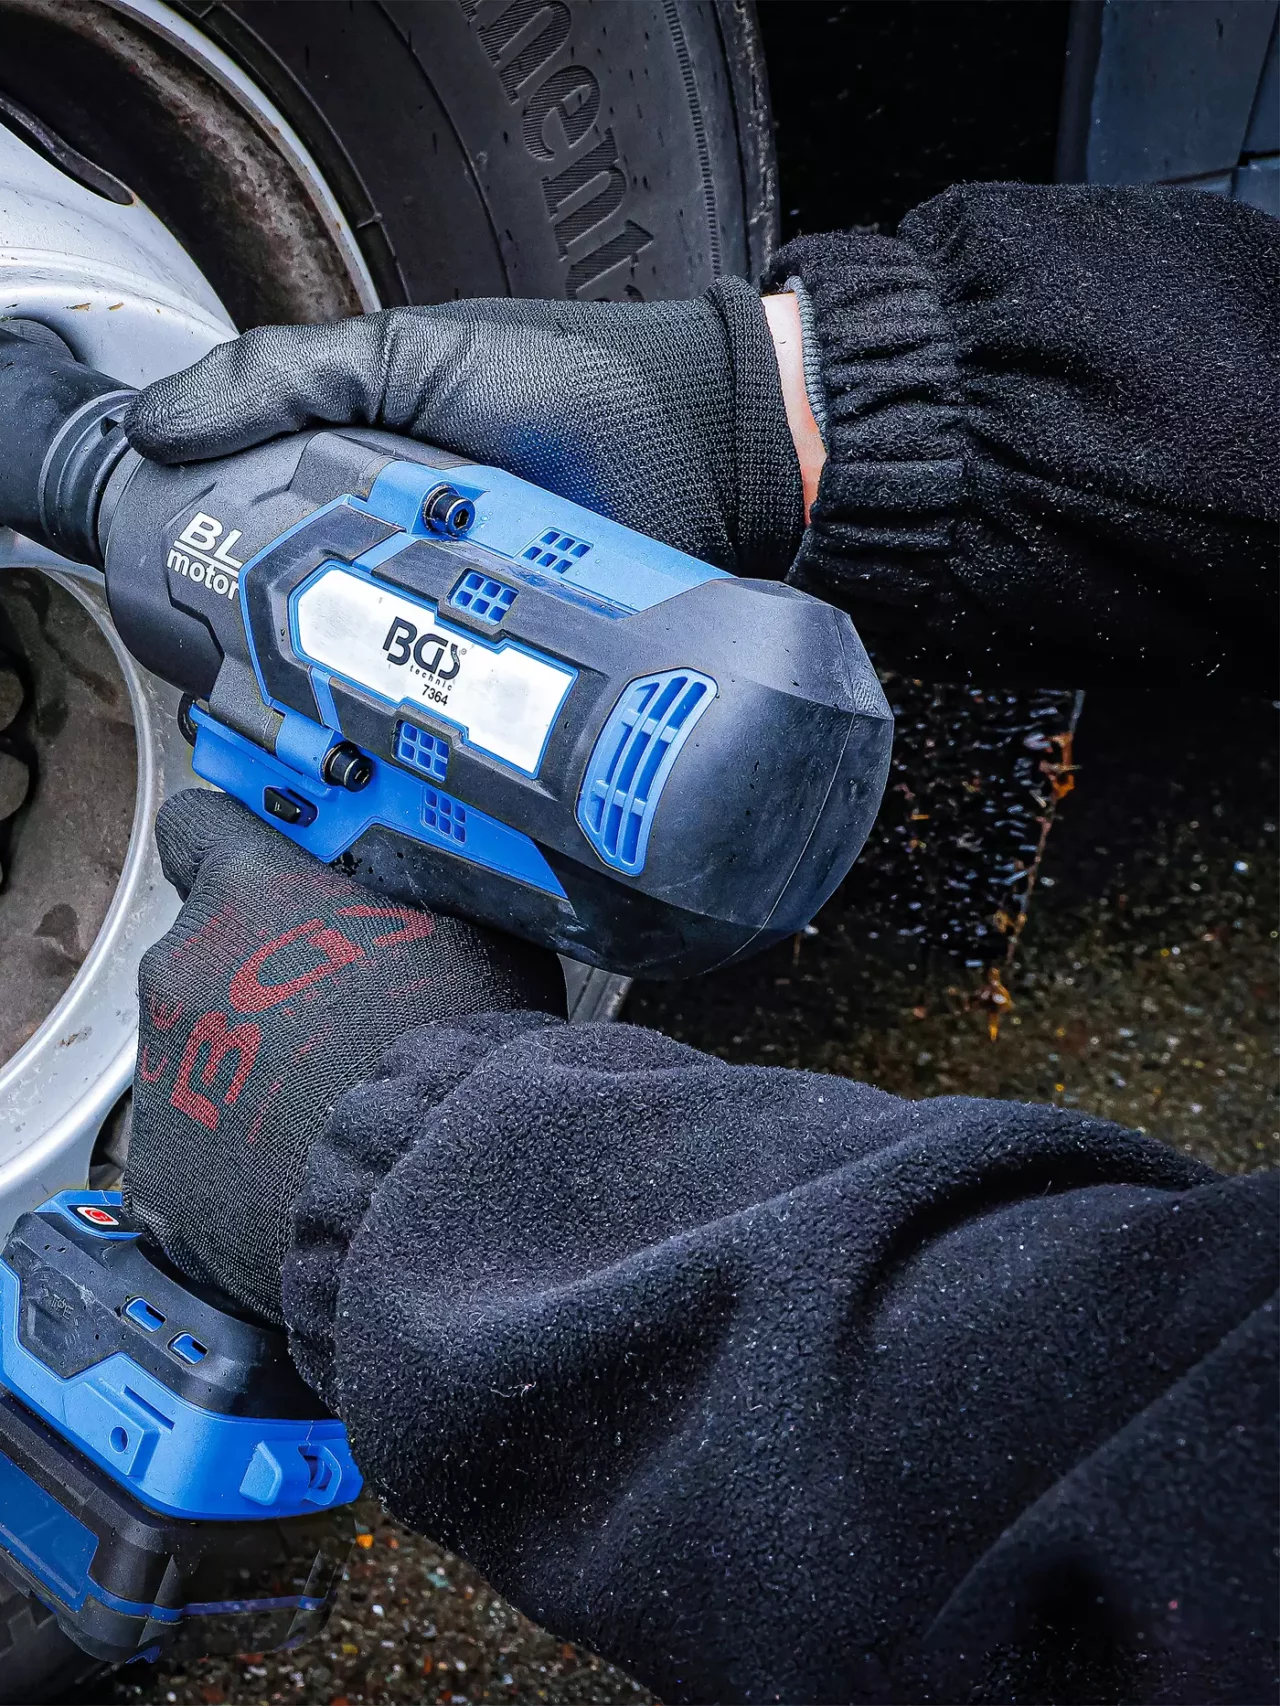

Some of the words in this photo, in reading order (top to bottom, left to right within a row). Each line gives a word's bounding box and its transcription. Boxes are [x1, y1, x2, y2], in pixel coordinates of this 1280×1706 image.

[179, 511, 243, 569] BL
[166, 549, 240, 600] motor
[382, 616, 461, 680] BGS
[409, 664, 453, 691] technic
[422, 684, 449, 707] 7364
